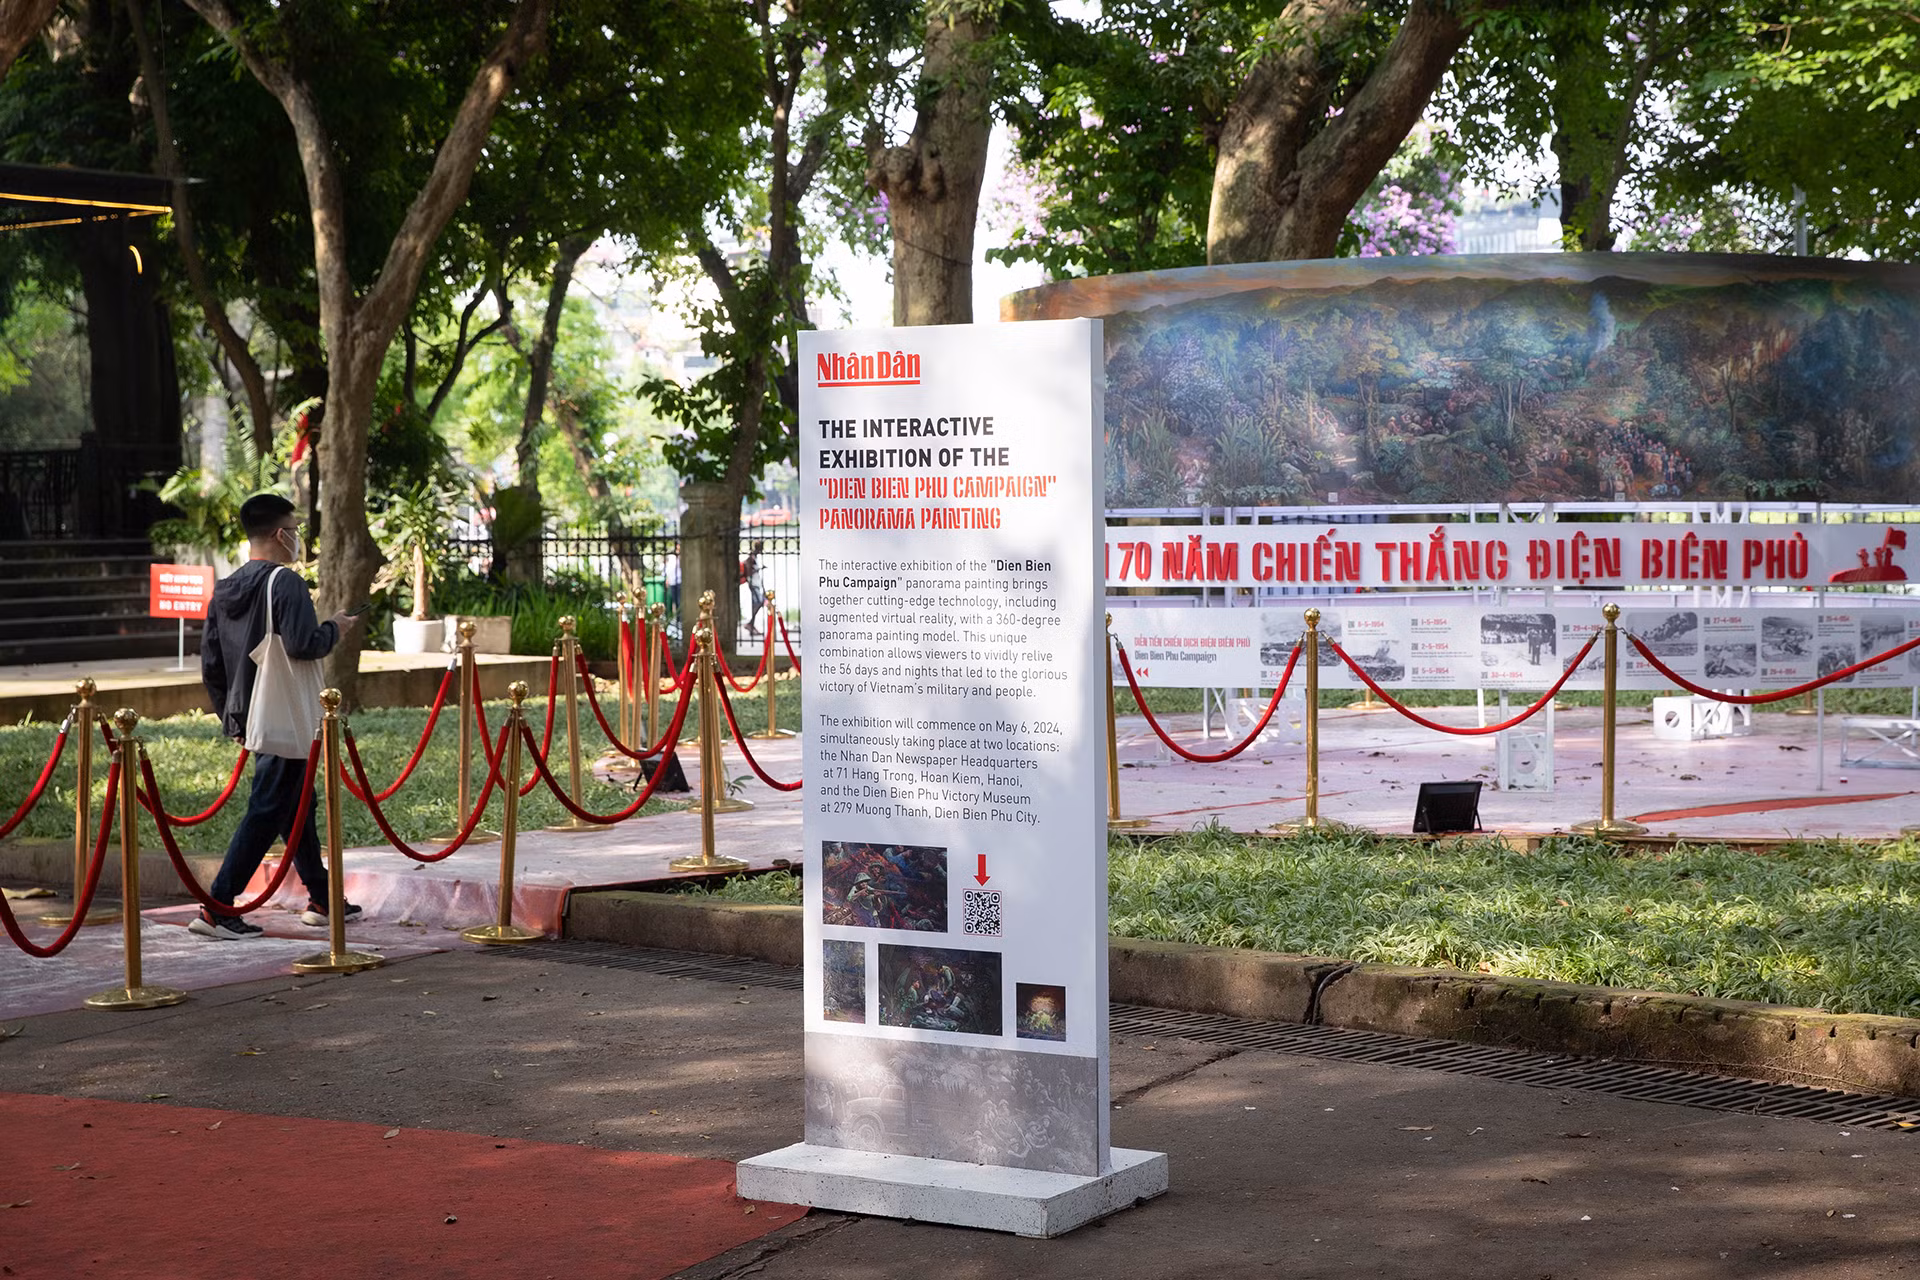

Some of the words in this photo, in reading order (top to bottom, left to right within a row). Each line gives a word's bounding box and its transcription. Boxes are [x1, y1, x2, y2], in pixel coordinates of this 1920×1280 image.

[818, 352, 874, 380] Nhân
[878, 350, 920, 379] Dân
[819, 420, 856, 438] THE
[864, 417, 993, 438] INTERACTIVE
[820, 448, 931, 468] EXHIBITION
[939, 448, 963, 467] OF
[970, 448, 1009, 466] THE
[819, 478, 866, 499] "DIEN
[872, 477, 909, 498] BIEN
[915, 477, 948, 498] PHU
[954, 476, 1056, 498] CAMPAIGN"
[820, 508, 915, 530] PANORAMA
[921, 508, 1001, 529] PAINTING
[1117, 542, 1151, 581] 70
[1162, 534, 1238, 581] NĂM
[1252, 528, 1360, 582] CHIẾN
[1375, 526, 1508, 582] THẮNG
[1526, 531, 1621, 584] ĐIỆN
[1641, 532, 1728, 580] BIÊN
[1743, 532, 1809, 580] PHỦ
[819, 559, 838, 570] The
[842, 560, 897, 571] interactive
[900, 560, 952, 571] exhibition
[956, 560, 966, 571] of
[970, 560, 987, 571] the
[991, 560, 1022, 571] "Dien
[1026, 560, 1050, 571] Bien
[820, 577, 839, 587] Phu
[843, 576, 902, 590] Campaign"
[906, 580, 960, 591] panorama
[965, 578, 1010, 592] painting
[1012, 576, 1048, 592] brings
[159, 600, 172, 610] NO
[174, 601, 202, 611] ENTRY
[819, 594, 864, 608] together
[867, 595, 935, 609] cutting-edge
[938, 595, 1001, 610] technology,
[1006, 596, 1056, 611] including
[819, 612, 878, 626] augmented
[882, 612, 916, 623] virtual
[920, 613, 956, 627] reality,
[960, 614, 982, 624] with
[986, 616, 992, 624] a
[997, 613, 1060, 629] 360-degree
[820, 631, 872, 642] panorama
[876, 630, 919, 644] painting
[923, 630, 959, 642] model.
[963, 630, 986, 642] This
[990, 632, 1027, 646] unique
[820, 646, 884, 658] combination
[888, 647, 922, 659] allows
[925, 648, 967, 660] viewers
[971, 650, 981, 660] to
[984, 650, 1018, 664] vividly
[1022, 650, 1052, 662] relive
[1135, 651, 1148, 660] Dien
[1150, 651, 1164, 660] Bien
[1166, 651, 1178, 660] Phu
[1180, 651, 1216, 663] Campaign
[820, 663, 836, 674] the
[840, 663, 851, 674] 56
[855, 664, 878, 678] days
[882, 665, 901, 676] and
[905, 665, 938, 680] nights
[942, 666, 962, 677] that
[966, 666, 982, 678] led
[986, 668, 996, 678] to
[1000, 667, 1018, 679] the
[1022, 668, 1067, 682] glorious
[819, 681, 854, 695] victory
[857, 681, 867, 692] of
[870, 682, 924, 694] Vietnam's
[926, 683, 970, 698] military
[972, 685, 991, 696] and
[996, 686, 1036, 700] people.
[820, 715, 838, 727] The
[842, 717, 892, 728] exhibition
[895, 718, 914, 729] will
[916, 721, 976, 732] commence
[978, 723, 992, 732] on
[996, 722, 1018, 734] May
[1021, 722, 1030, 734] 6,
[1034, 722, 1062, 735] 2024,
[820, 733, 900, 748] simultaneously
[903, 736, 935, 750] taking
[938, 737, 967, 749] place
[969, 738, 980, 750] at
[982, 739, 1003, 752] two
[1006, 740, 1060, 752] locations:
[820, 750, 838, 762] the
[840, 749, 868, 762] Nhan
[872, 751, 892, 763] Dan
[896, 752, 957, 766] Newspaper
[961, 756, 1038, 770] Headquarters
[823, 768, 834, 779] at
[836, 766, 847, 778] 71
[852, 768, 879, 783] Hang
[882, 769, 917, 784] Trong,
[921, 770, 949, 783] Hoan
[952, 772, 984, 786] Kiem,
[988, 775, 1022, 788] Hanoi,
[821, 784, 839, 796] and
[843, 785, 860, 797] the
[863, 785, 886, 798] Dien
[890, 787, 914, 799] Bien
[918, 788, 938, 800] Phu
[942, 790, 979, 804] Victory
[983, 792, 1031, 805] Museum
[821, 802, 830, 812] at
[834, 801, 852, 813] 279
[856, 802, 891, 818] Muong
[894, 804, 931, 819] Thanh,
[935, 807, 959, 818] Dien
[963, 808, 987, 820] Bien
[991, 809, 1012, 822] Phu
[1015, 810, 1040, 826] City.
